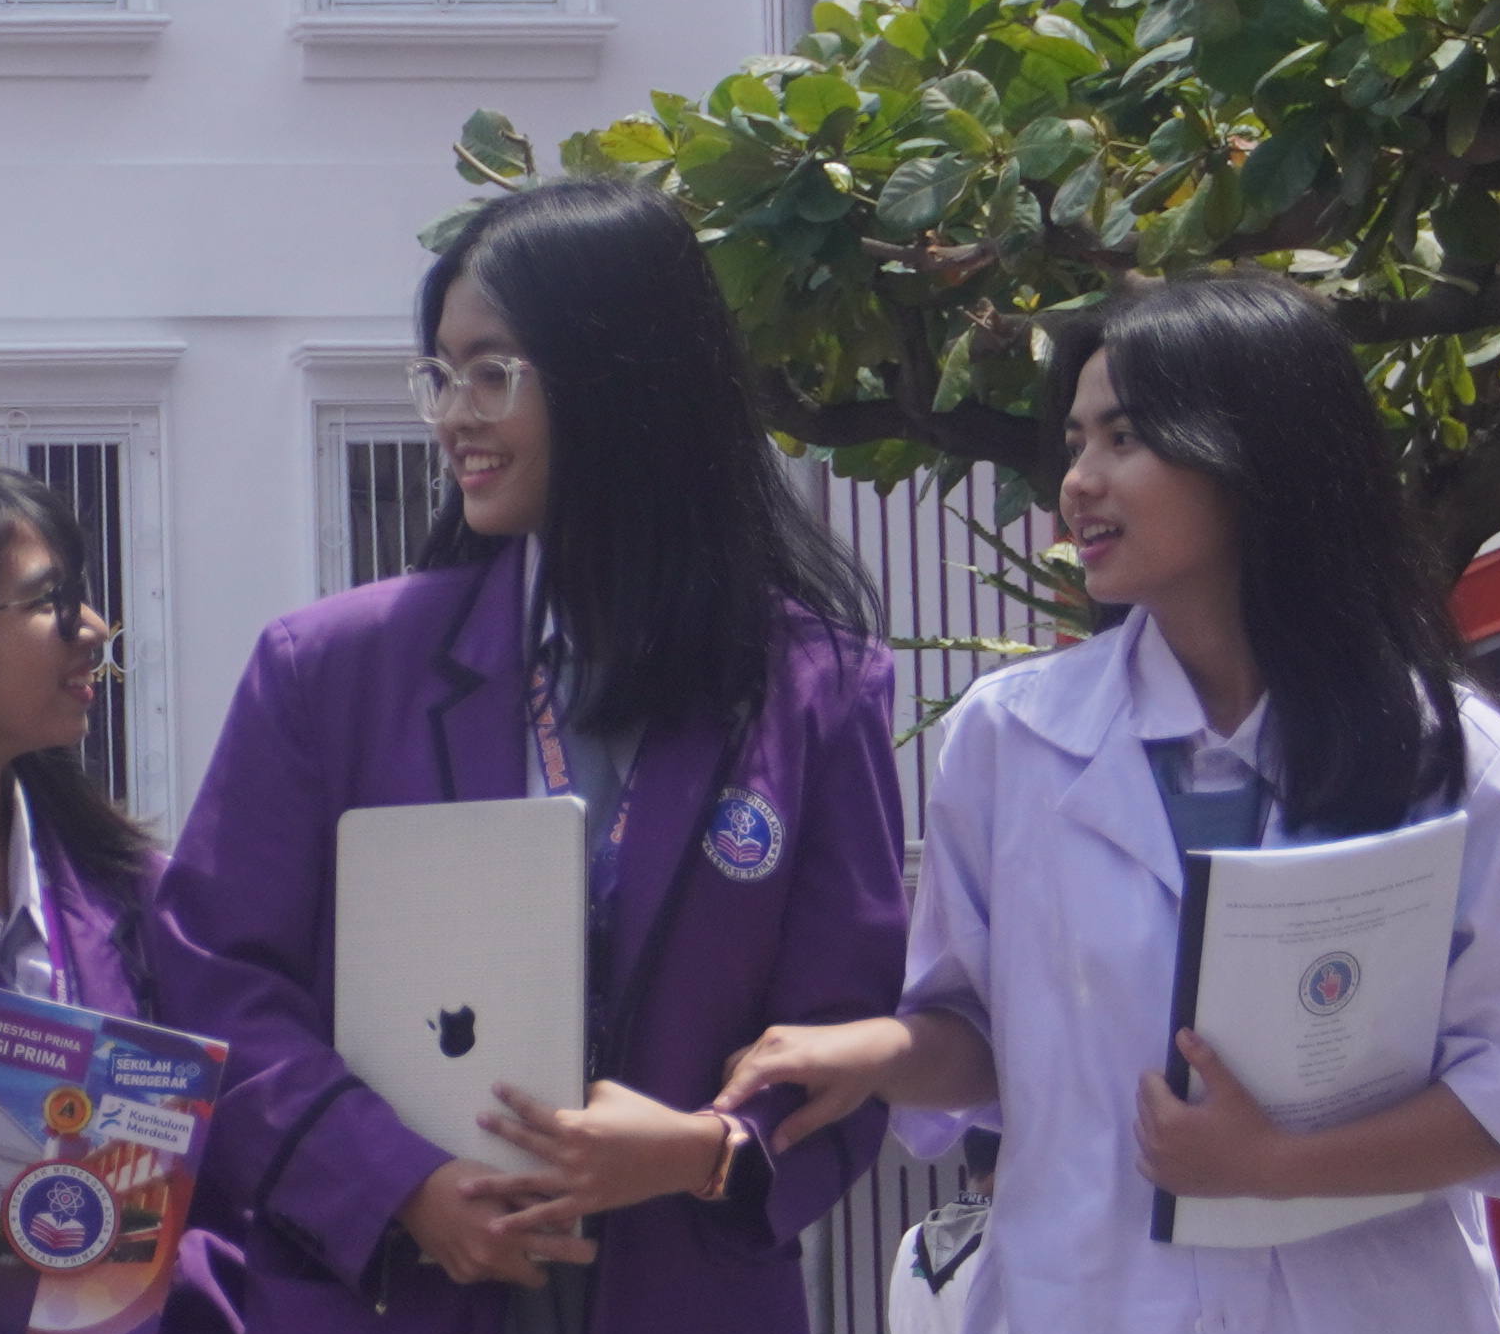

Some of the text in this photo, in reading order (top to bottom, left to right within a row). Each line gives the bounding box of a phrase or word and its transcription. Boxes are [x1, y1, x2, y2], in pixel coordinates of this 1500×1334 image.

[44, 1033, 81, 1053] PRIMA
[12, 1043, 67, 1071] PRIMA
[115, 1058, 172, 1074] SEKOLAH
[114, 1073, 188, 1089] PENGGERAK
[129, 1109, 190, 1133] Kurikulum
[126, 1121, 178, 1143] Merdeka
